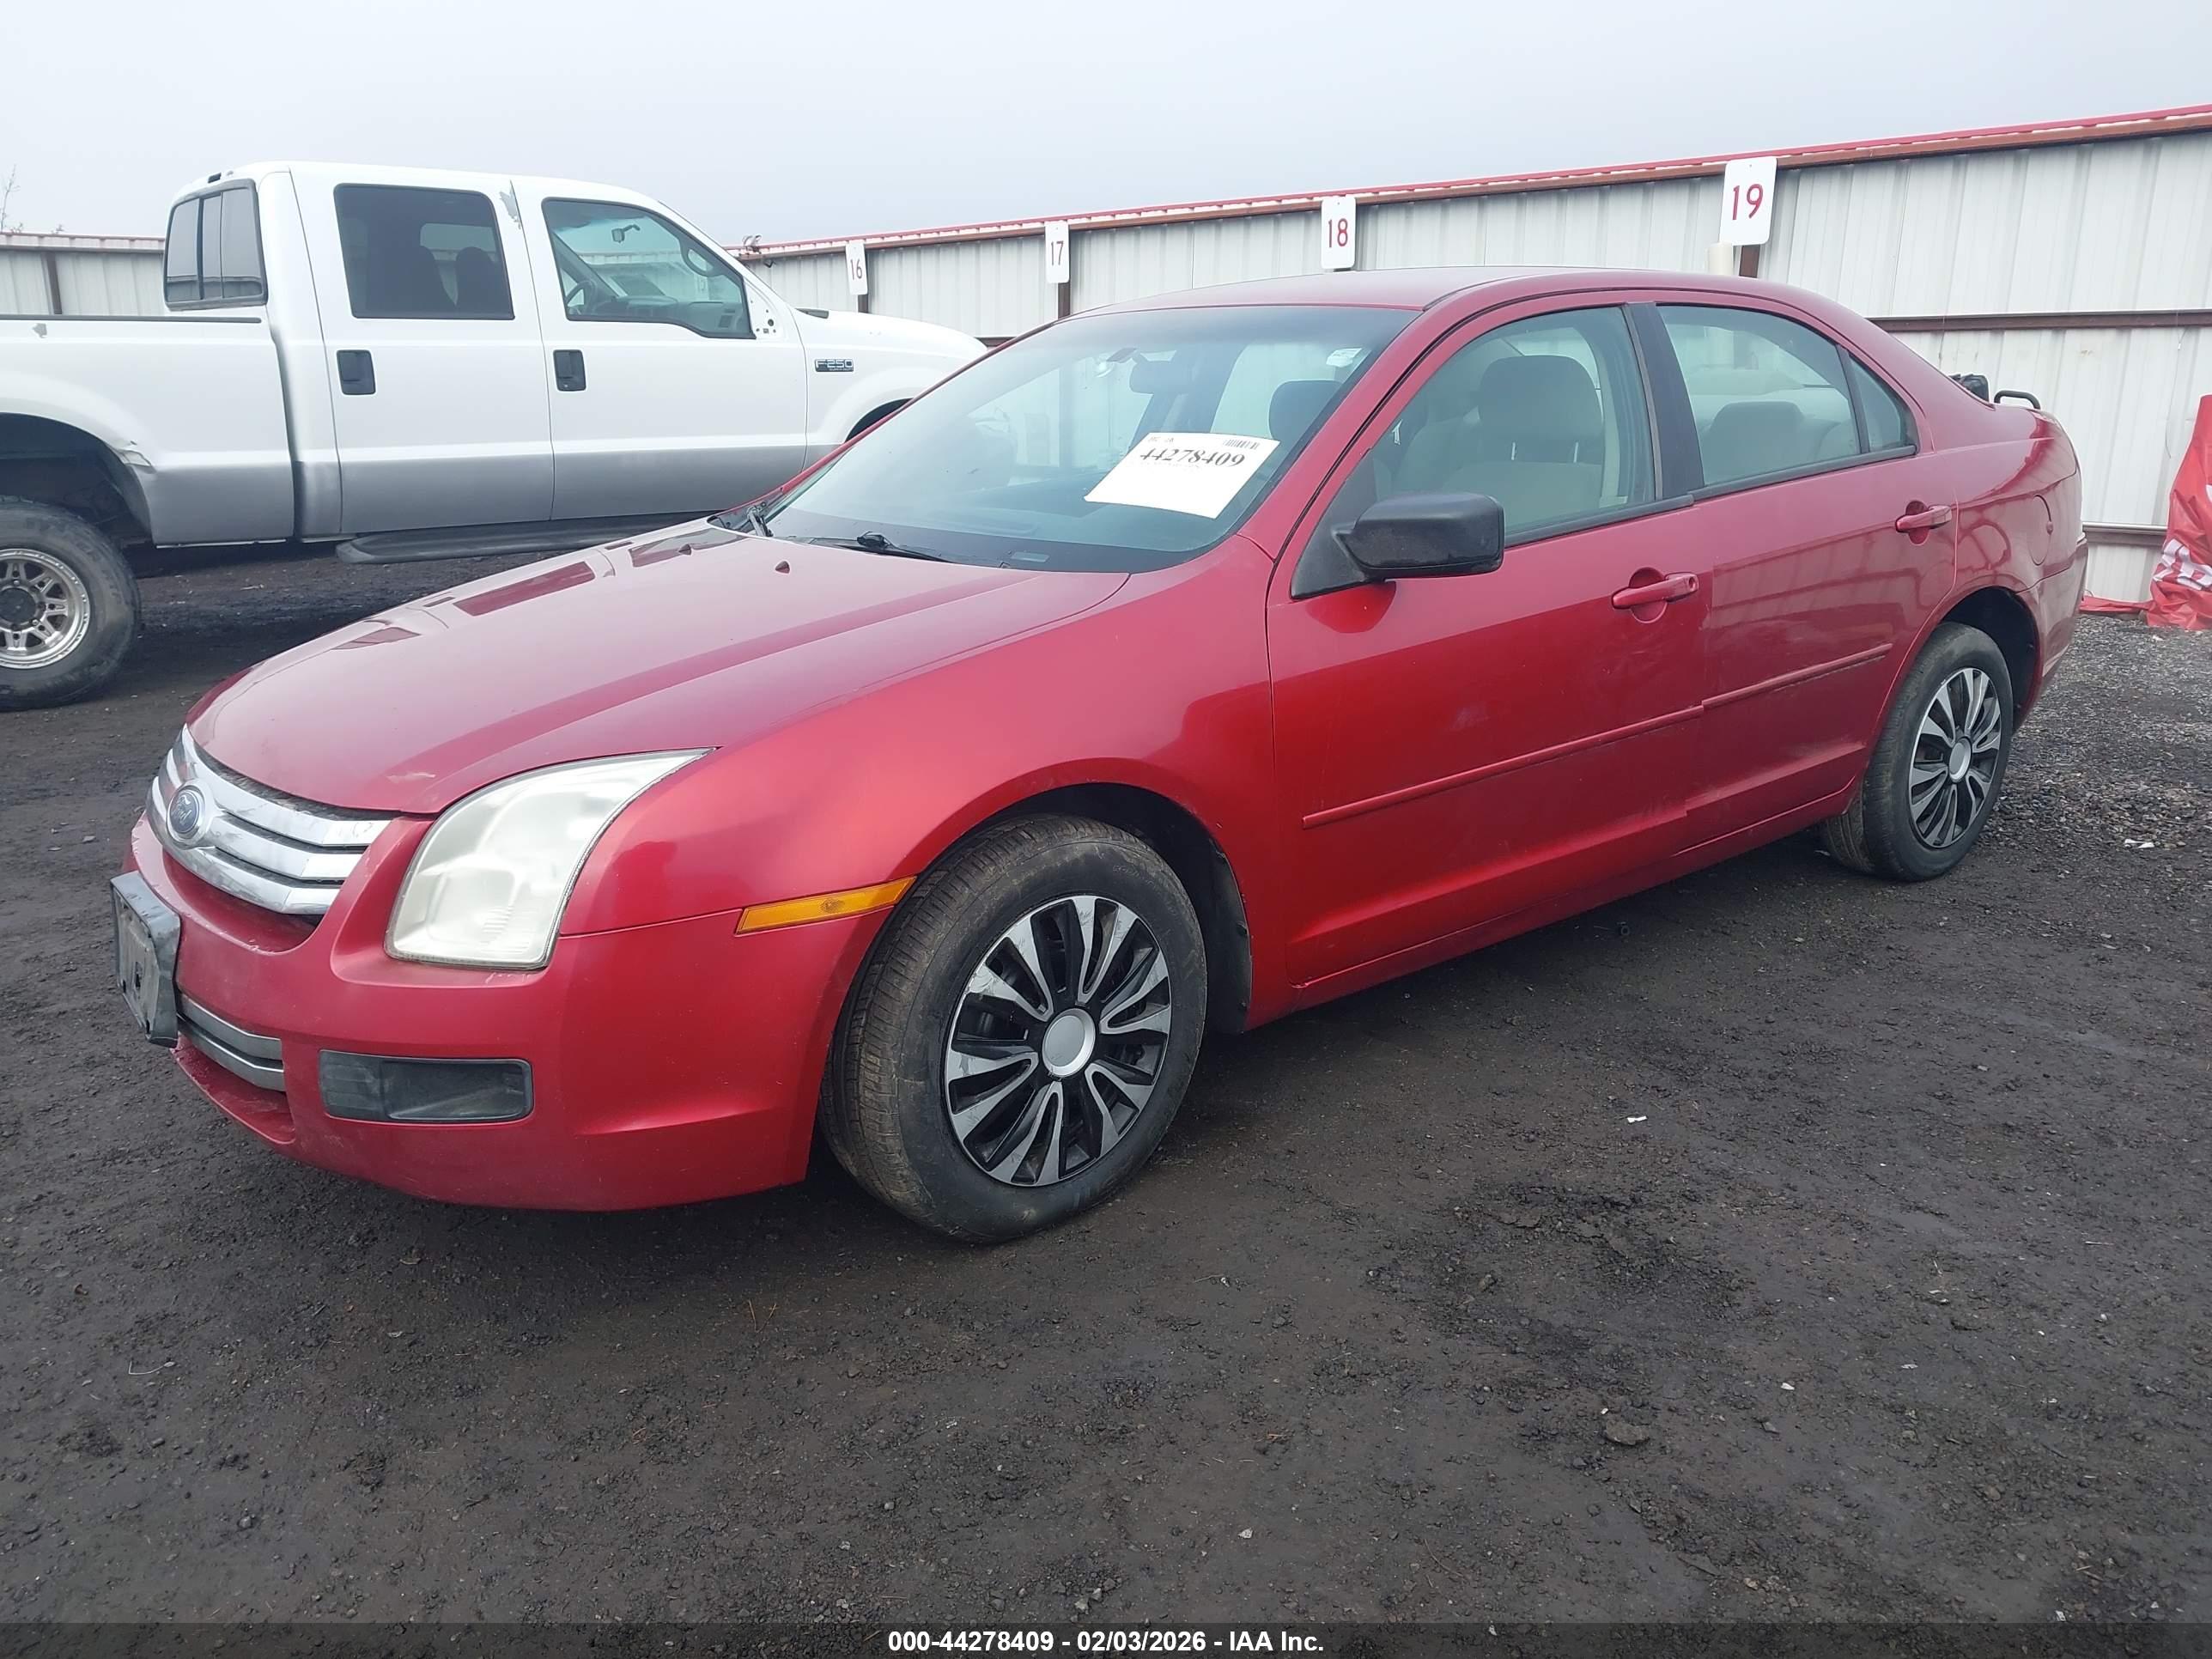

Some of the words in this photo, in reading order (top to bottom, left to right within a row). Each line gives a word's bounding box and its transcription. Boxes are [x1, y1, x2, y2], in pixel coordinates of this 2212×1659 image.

[1732, 183, 1763, 221] 19
[1328, 217, 1349, 247] 18
[1050, 240, 1064, 266] 17
[850, 258, 863, 281] 16
[1139, 447, 1245, 467] 44278409
